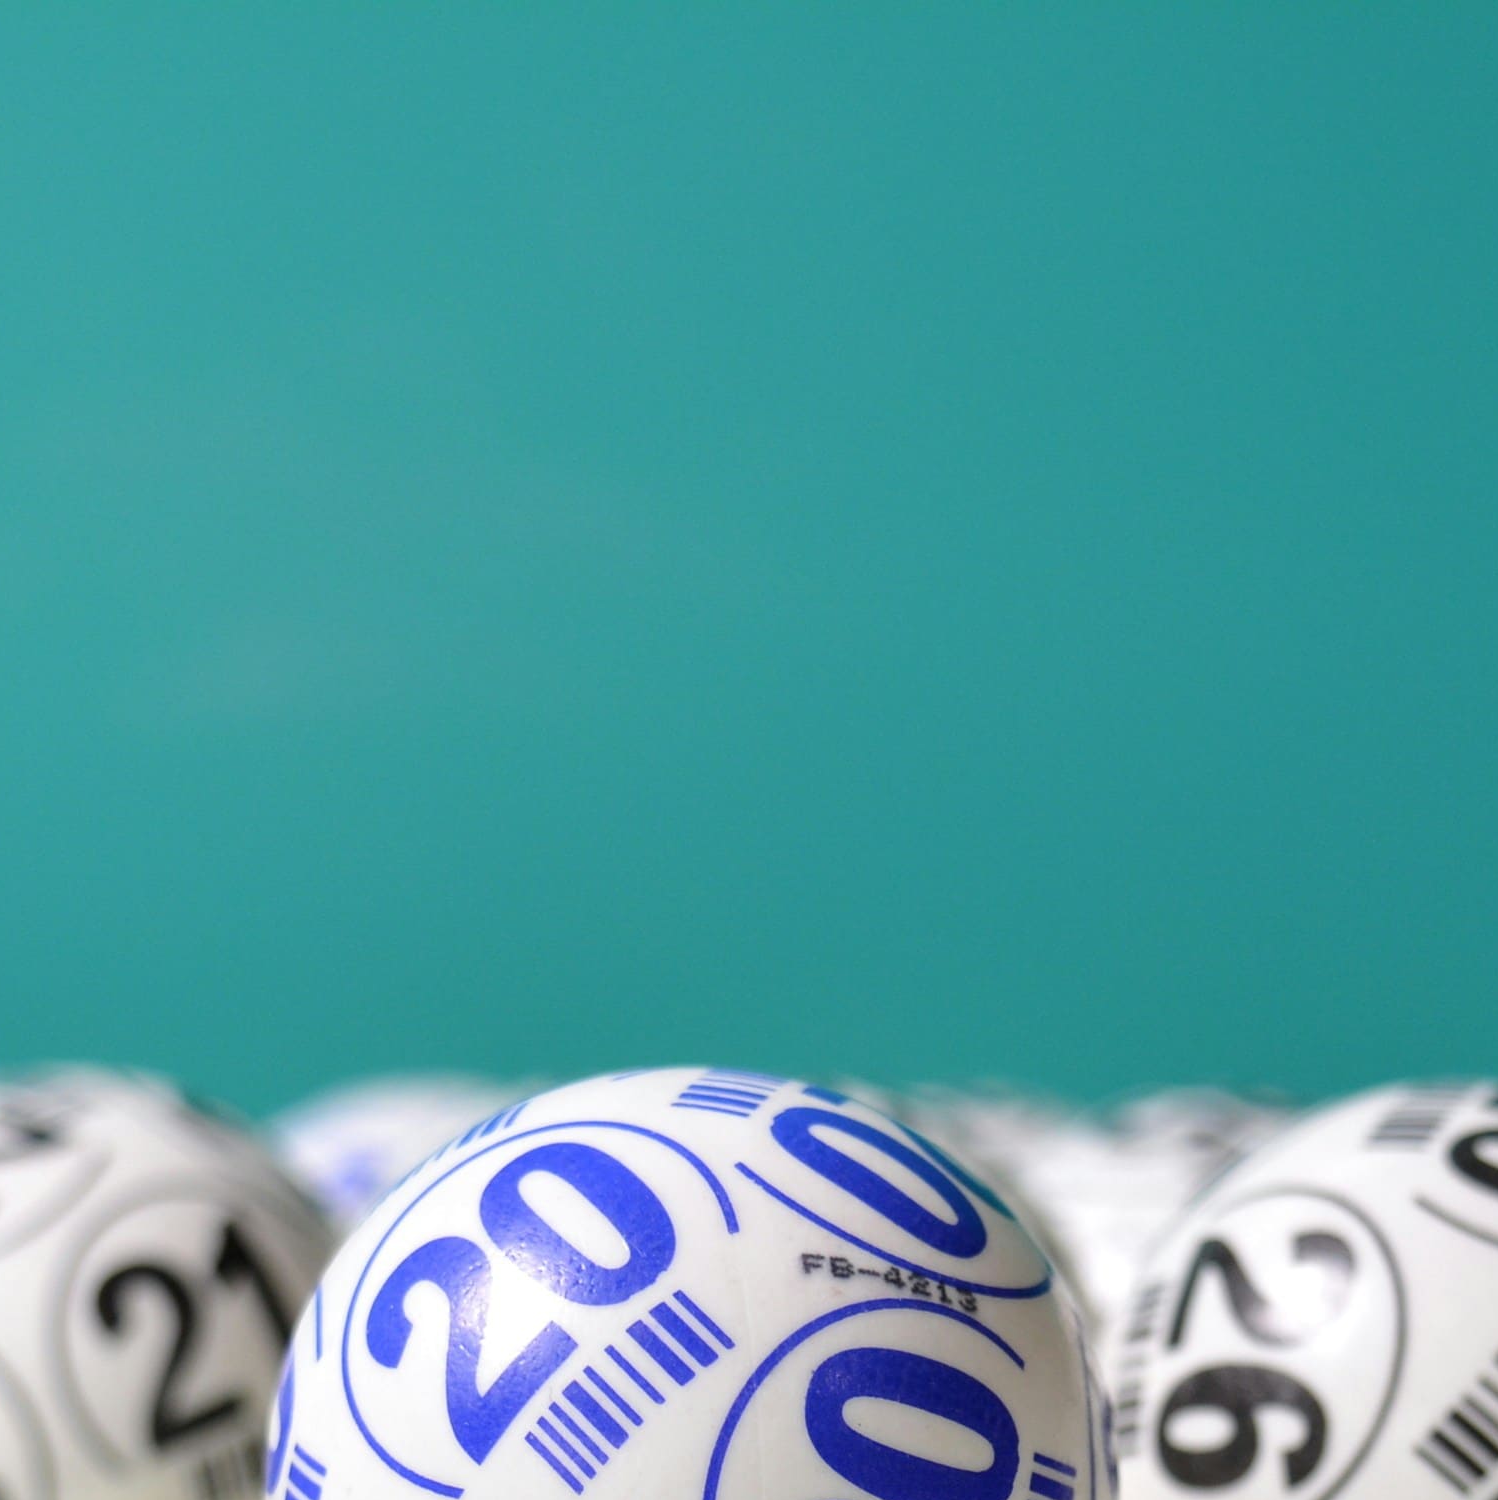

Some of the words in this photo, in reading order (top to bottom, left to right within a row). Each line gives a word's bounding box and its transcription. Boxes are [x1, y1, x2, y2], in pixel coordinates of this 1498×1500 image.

[95, 1216, 299, 1450] 21
[366, 1141, 677, 1466] 20
[800, 1252, 978, 1314] FB-4213
[1157, 1228, 1356, 1492] 26
